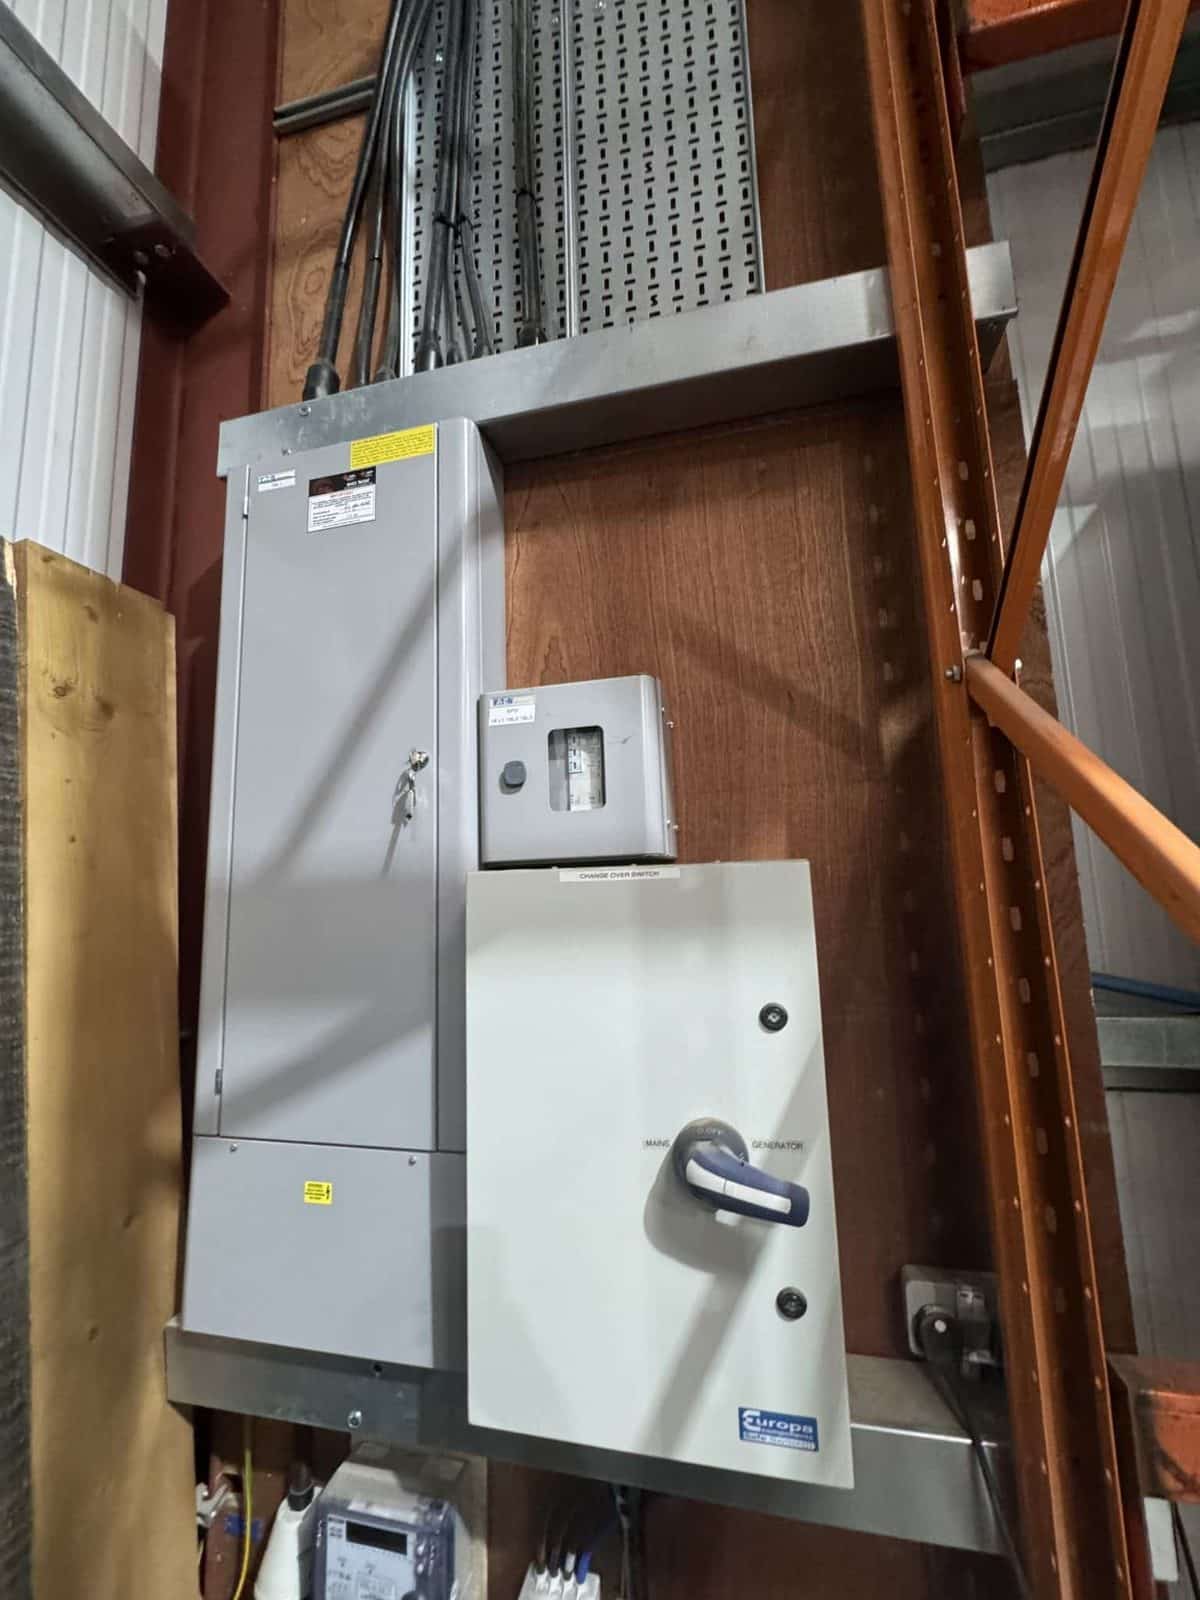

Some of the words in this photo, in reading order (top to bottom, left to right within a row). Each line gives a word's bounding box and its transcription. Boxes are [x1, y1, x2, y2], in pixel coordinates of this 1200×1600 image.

[645, 1139, 672, 1148] MAINS
[752, 1139, 804, 1151] GENERATOR
[742, 1409, 814, 1434] Europa
